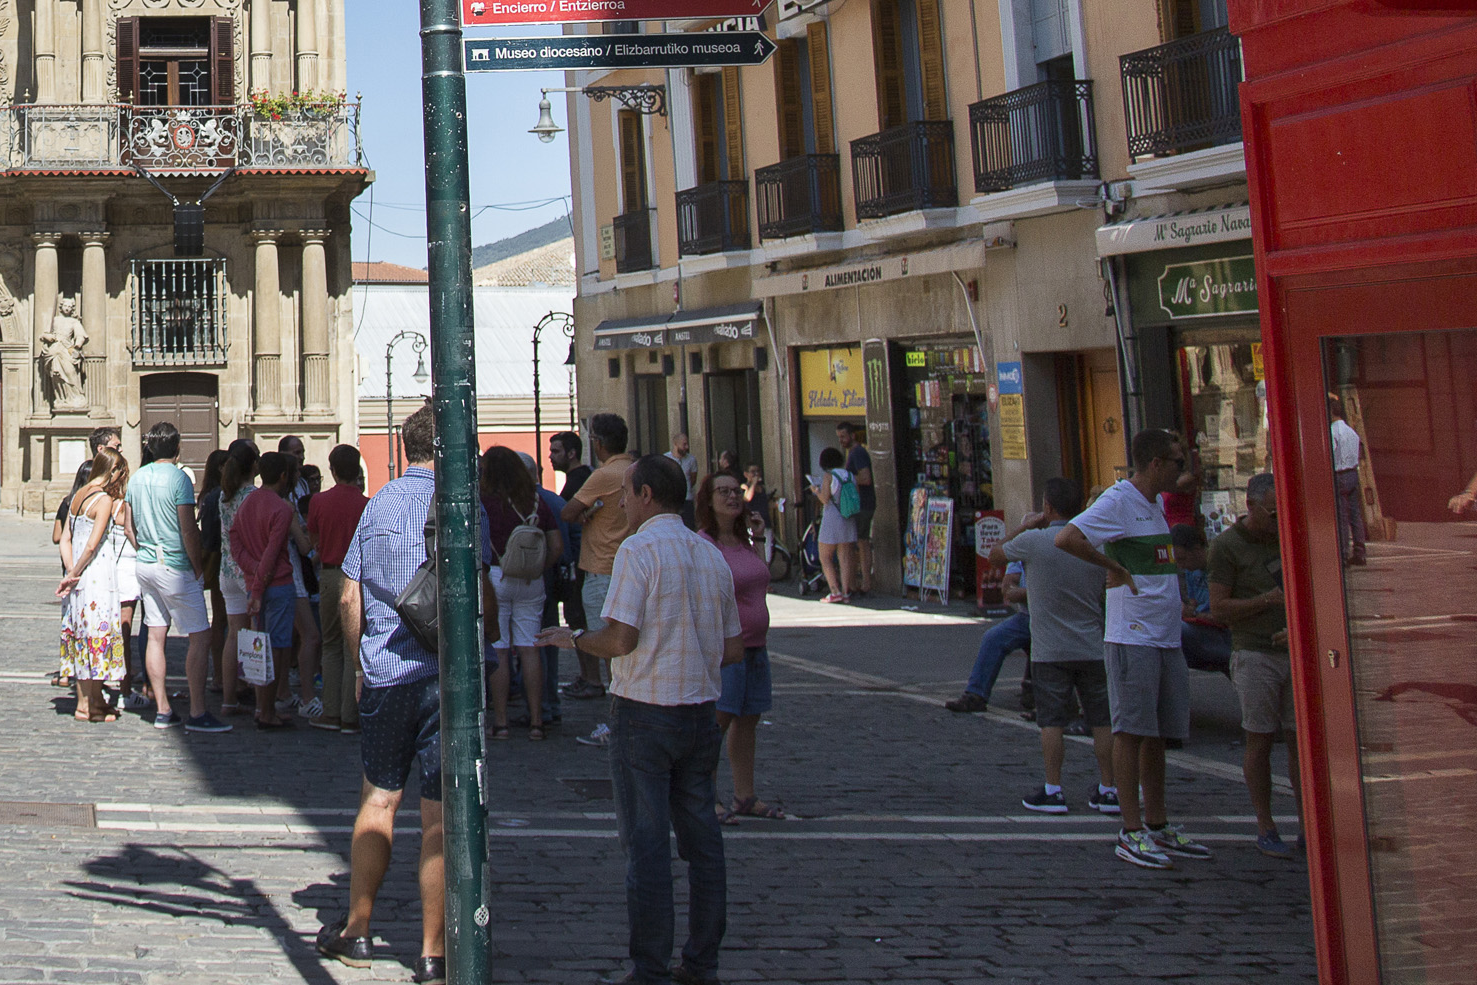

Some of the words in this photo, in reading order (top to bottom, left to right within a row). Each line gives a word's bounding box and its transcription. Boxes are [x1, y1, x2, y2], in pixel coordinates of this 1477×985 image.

[492, 2, 546, 14] Encierro
[559, 0, 625, 12] Entzierroa
[496, 48, 536, 60] Museo
[540, 46, 602, 58] diocesano
[615, 42, 688, 56] Elizbarrutiko
[692, 44, 741, 54] museoa
[1170, 220, 1218, 243] Sagrario
[824, 263, 882, 288] ALIMENTACIÓN
[1058, 304, 1069, 328] 2
